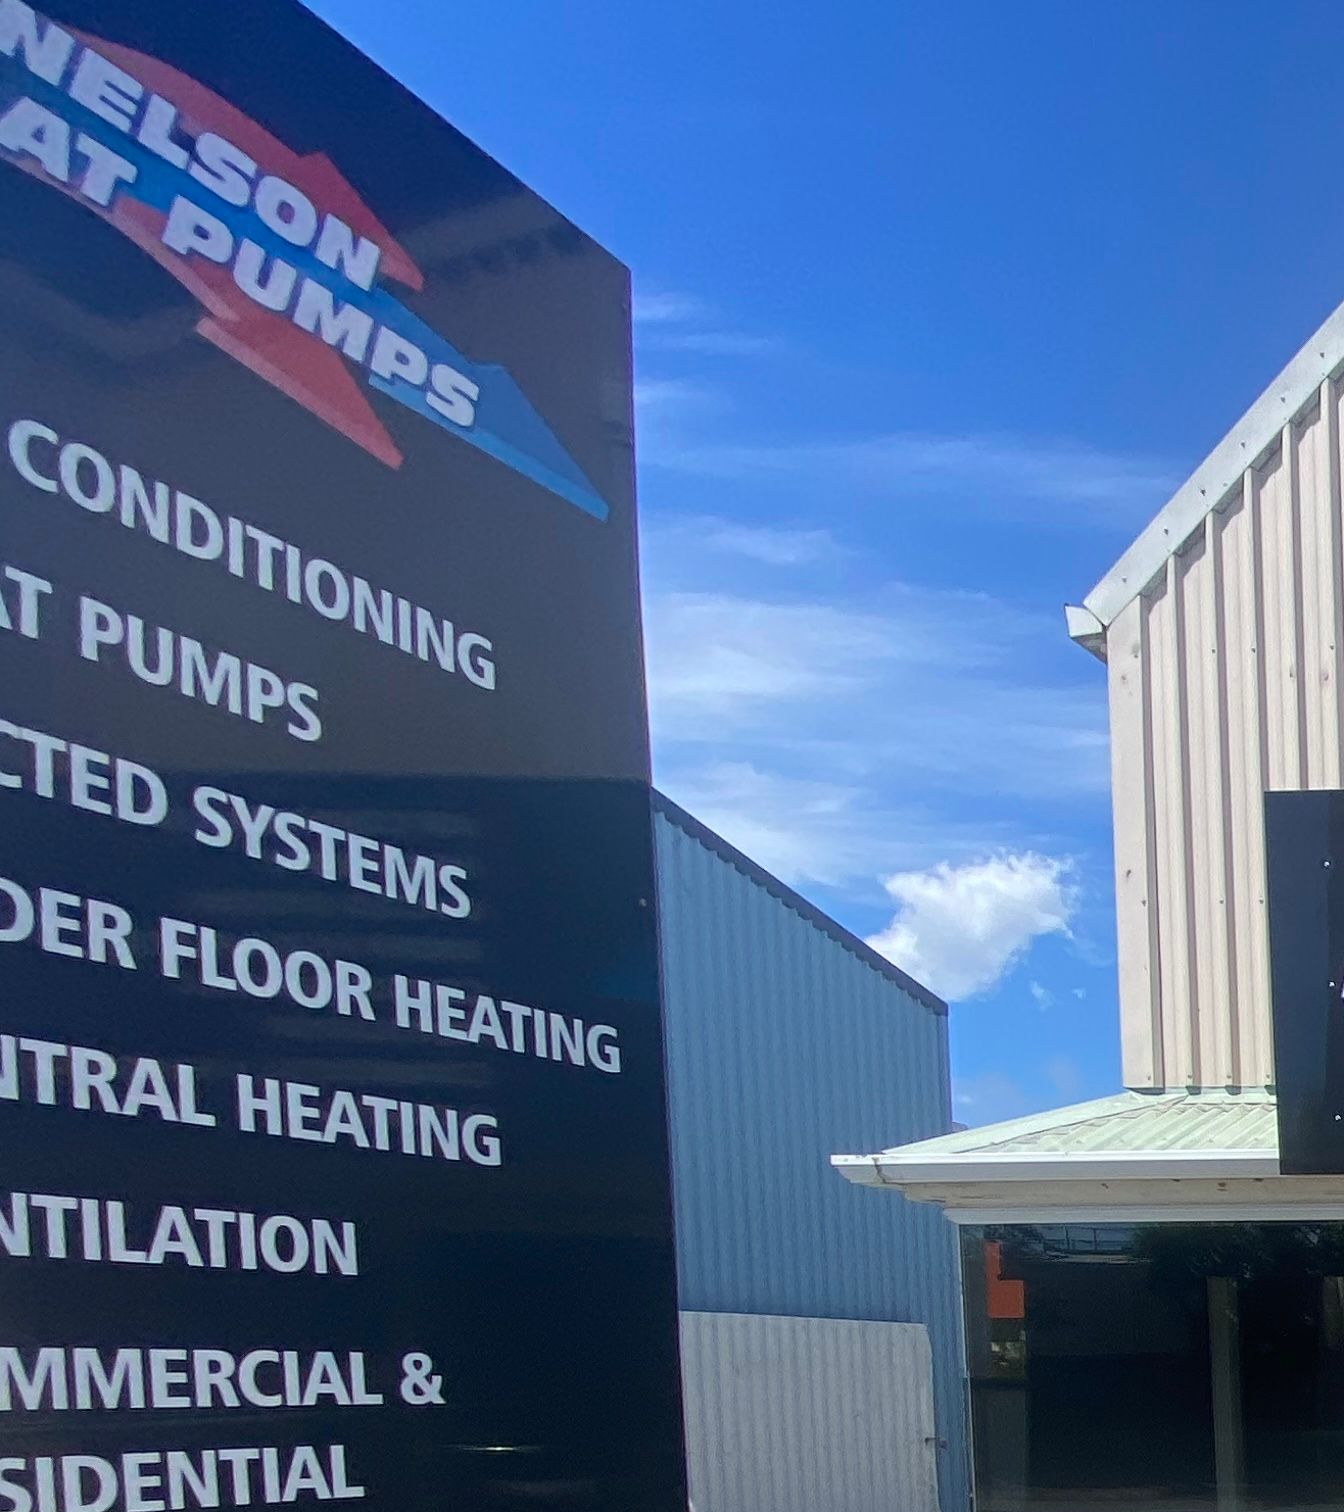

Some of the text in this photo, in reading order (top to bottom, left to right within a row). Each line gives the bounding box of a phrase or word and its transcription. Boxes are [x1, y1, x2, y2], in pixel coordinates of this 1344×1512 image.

[0, 0, 381, 291] NELSON
[161, 195, 480, 428] PUMPS
[8, 419, 497, 690] CONDITIONING
[79, 596, 323, 743] PUMPS
[193, 785, 472, 919] SYSTEMS
[159, 916, 375, 1021] FLOOR
[393, 974, 622, 1074] HEATING
[236, 1072, 503, 1167] HEATING
[400, 1351, 447, 1405] &
